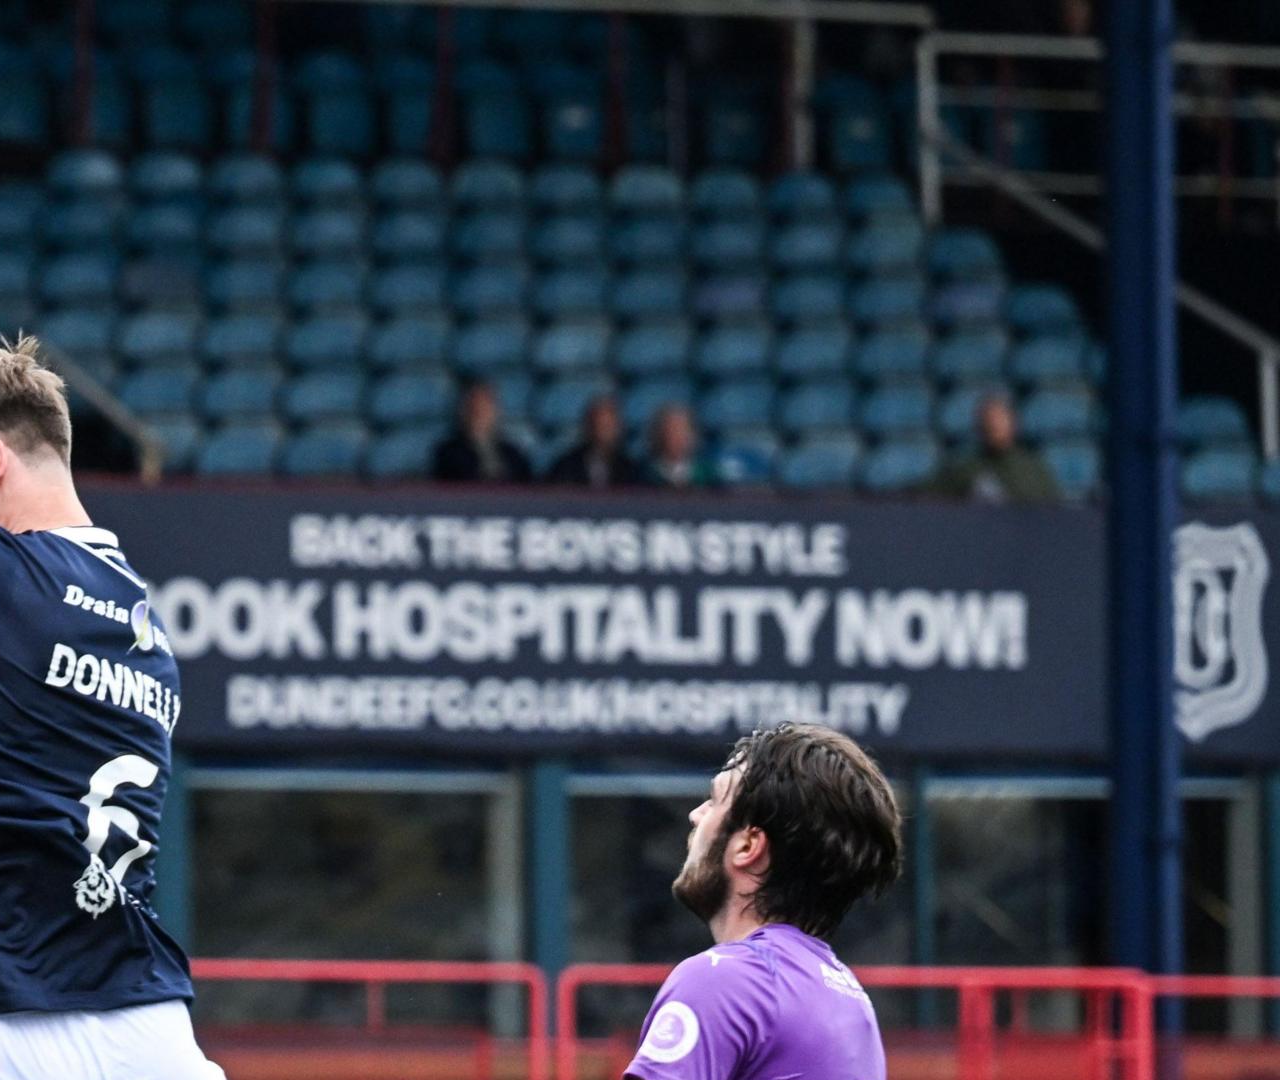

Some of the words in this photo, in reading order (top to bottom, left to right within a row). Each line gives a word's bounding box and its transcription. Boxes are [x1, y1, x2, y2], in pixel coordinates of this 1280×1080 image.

[290, 513, 424, 567] BACK
[425, 514, 513, 568] THE
[517, 519, 645, 571] BOYS
[696, 522, 848, 576] STYLE
[63, 584, 130, 624] Drain
[145, 576, 326, 660] OOK
[332, 581, 830, 668] HOSPITALITY
[836, 589, 1029, 670] NOW!
[79, 754, 159, 884] 6
